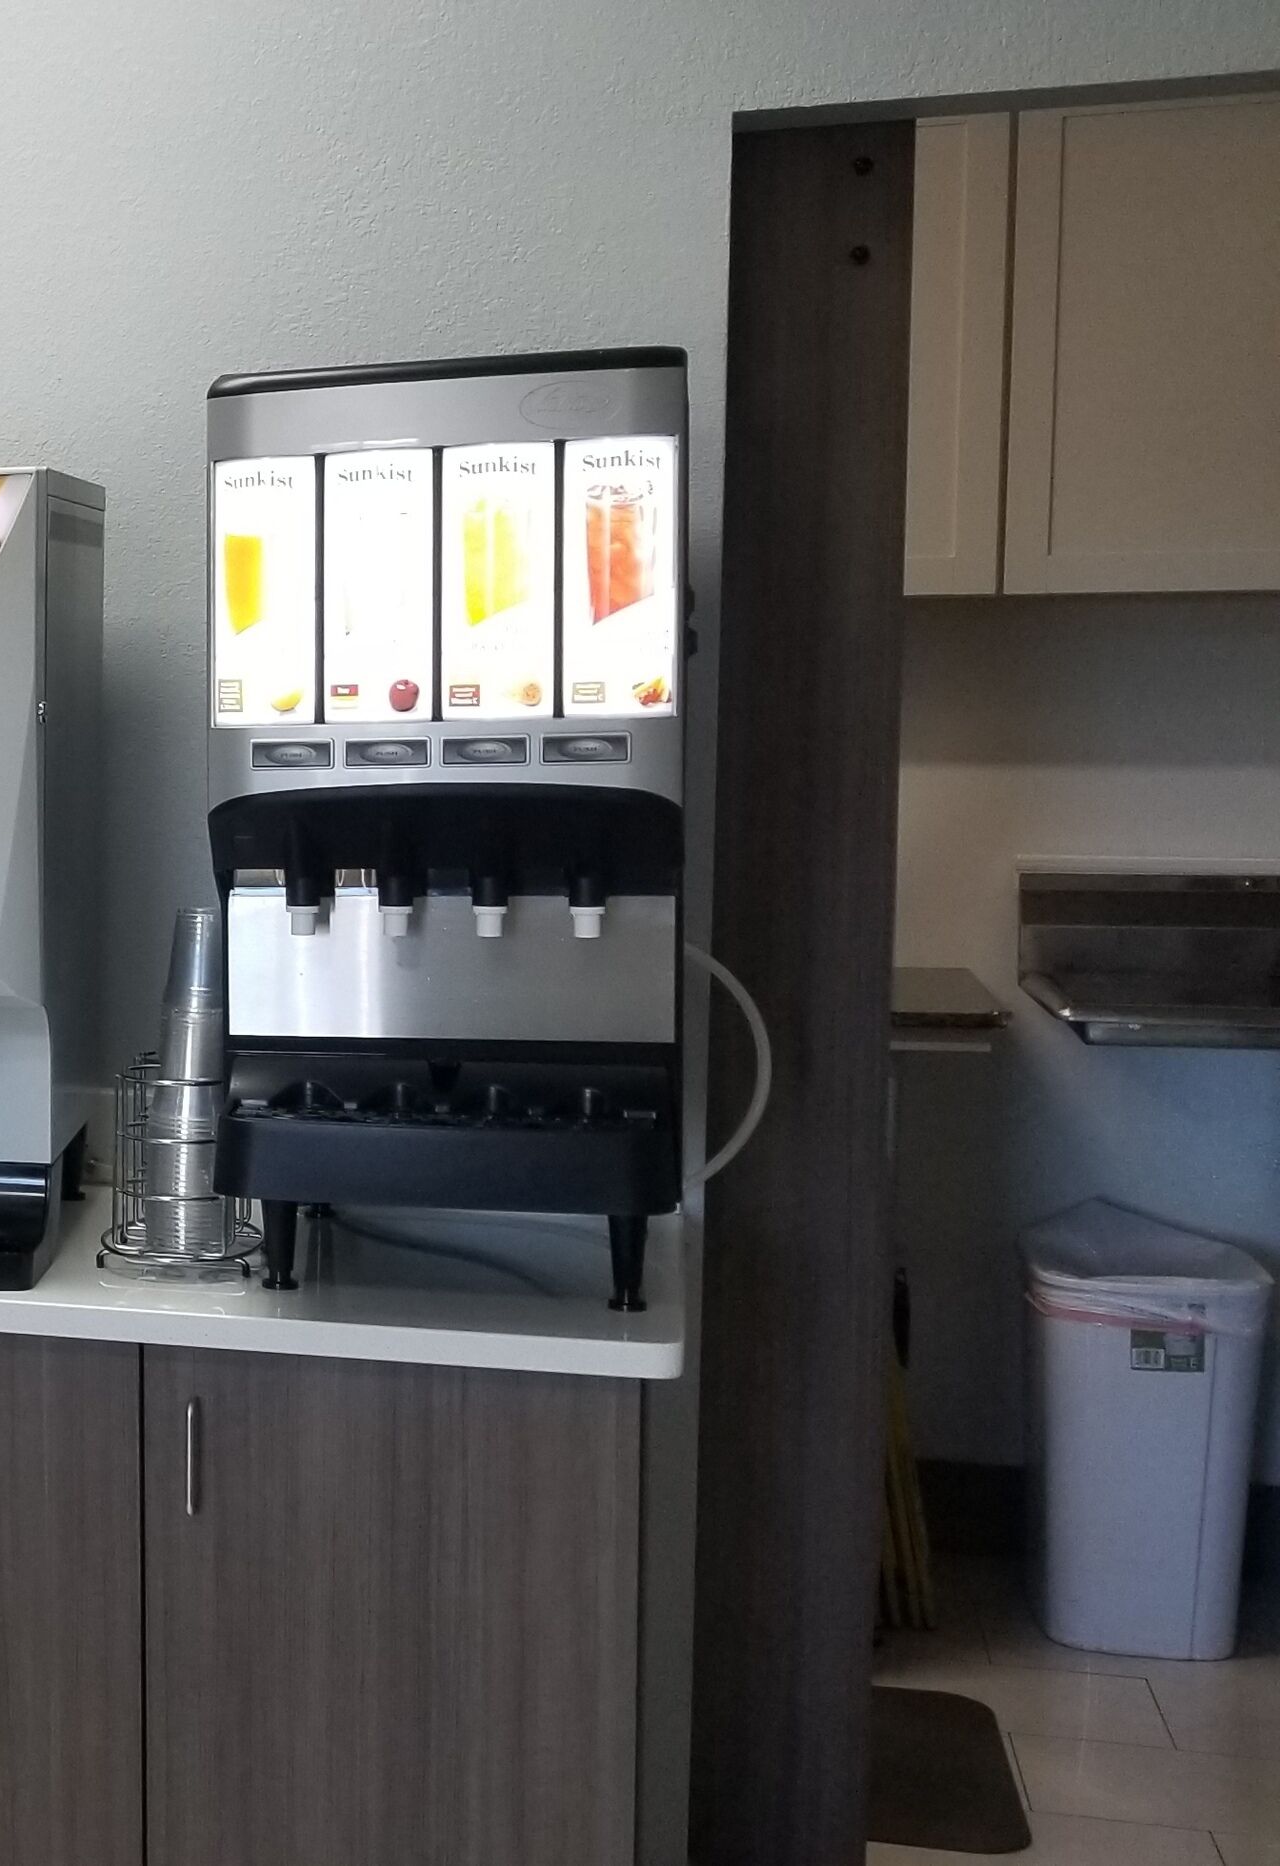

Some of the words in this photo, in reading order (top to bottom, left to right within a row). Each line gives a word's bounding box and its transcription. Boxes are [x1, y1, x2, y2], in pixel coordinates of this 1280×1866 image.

[458, 457, 538, 478] Sunkist
[582, 449, 663, 472] Sunkist
[336, 465, 415, 484] Sunkist
